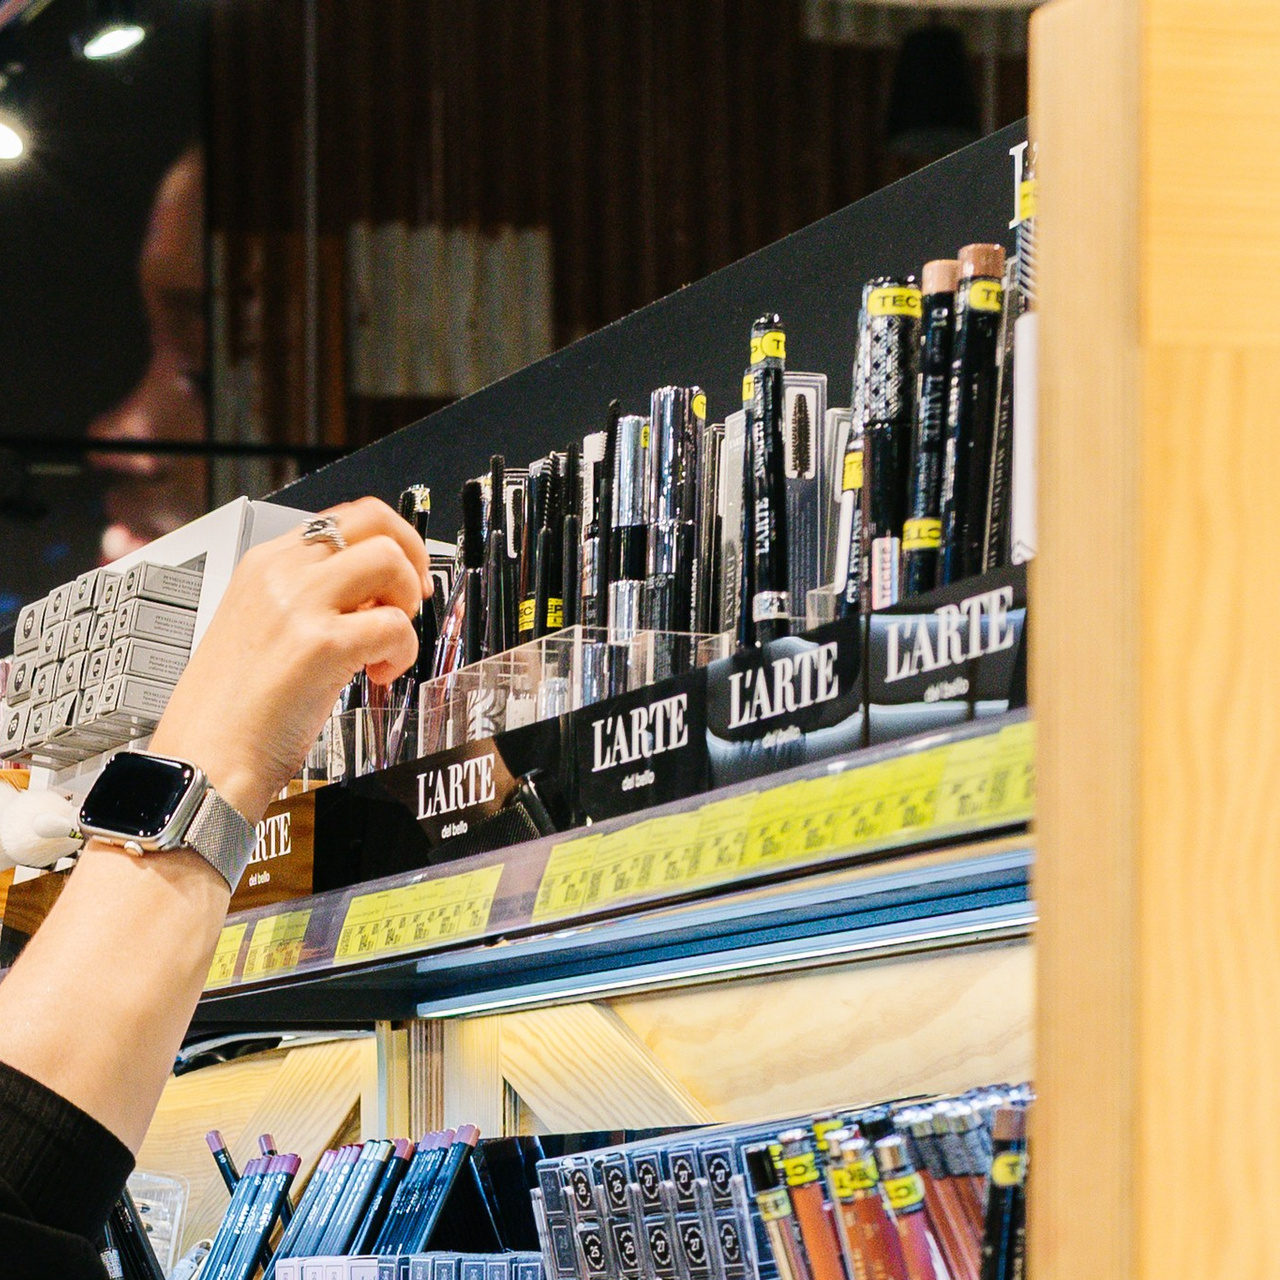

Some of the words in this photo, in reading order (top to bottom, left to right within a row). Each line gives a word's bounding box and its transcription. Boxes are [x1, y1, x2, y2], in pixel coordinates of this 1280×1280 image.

[876, 294, 922, 310] ТЕС
[884, 586, 1014, 684] L'ARTE
[727, 642, 839, 729] L'ARTE
[590, 693, 689, 772] L'ARTE
[416, 753, 496, 820] L'ARTE
[247, 811, 292, 865] RTE
